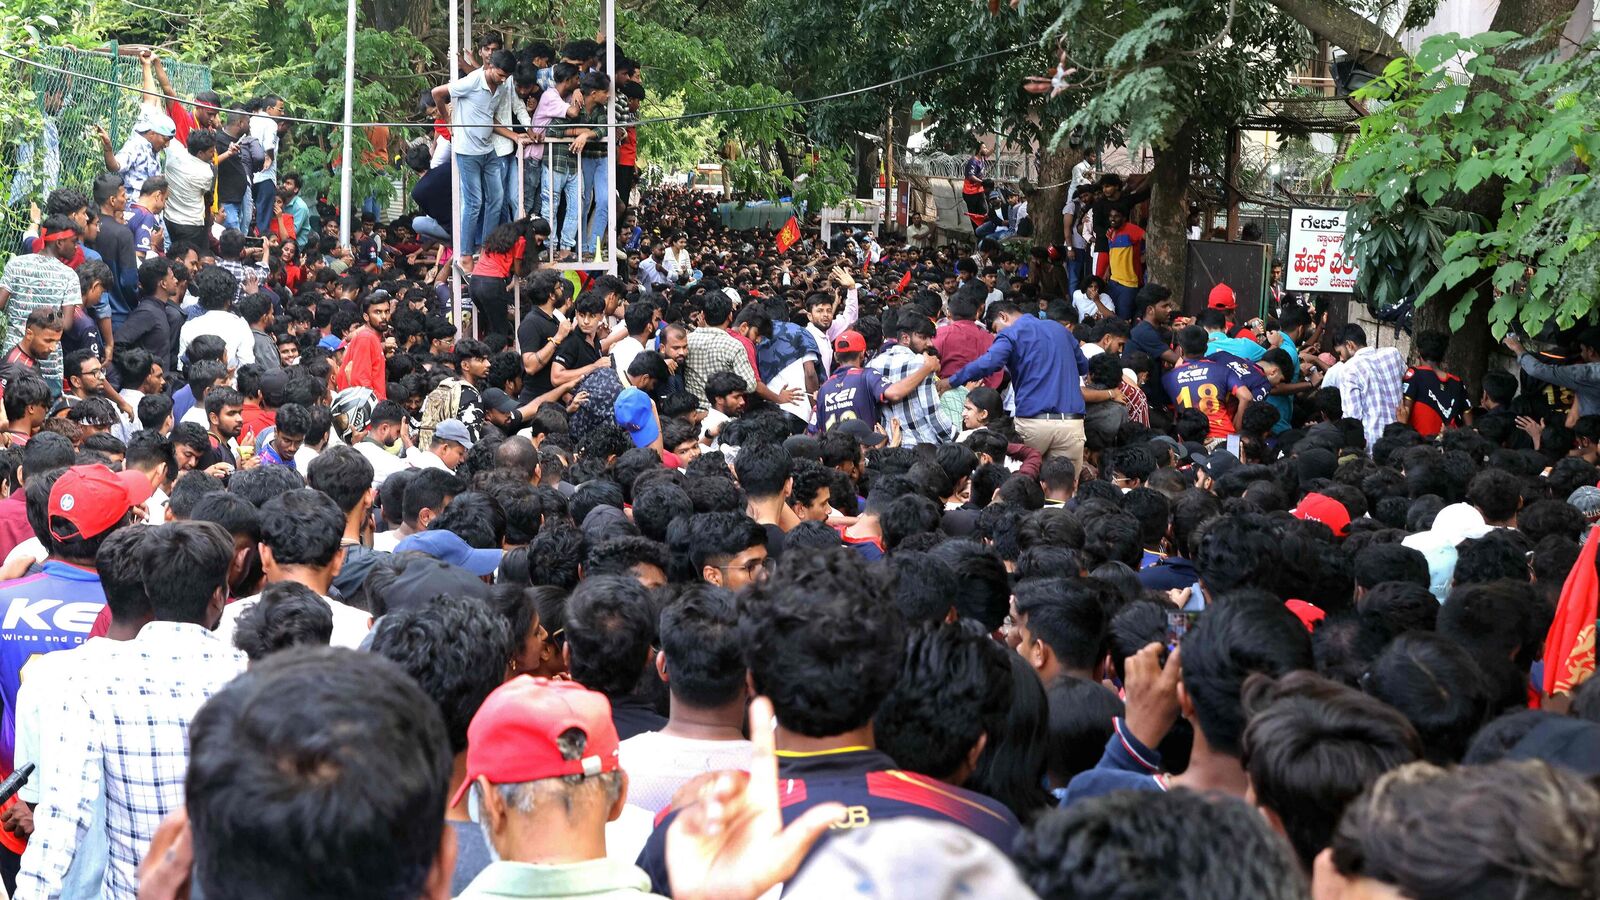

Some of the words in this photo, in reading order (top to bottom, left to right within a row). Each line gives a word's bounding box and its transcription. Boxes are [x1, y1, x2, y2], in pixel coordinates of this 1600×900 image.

[1178, 367, 1209, 380] KEI
[825, 388, 857, 406] KEI
[1176, 383, 1220, 415] 18
[2, 597, 106, 633] KE
[1, 633, 39, 641] Wires
